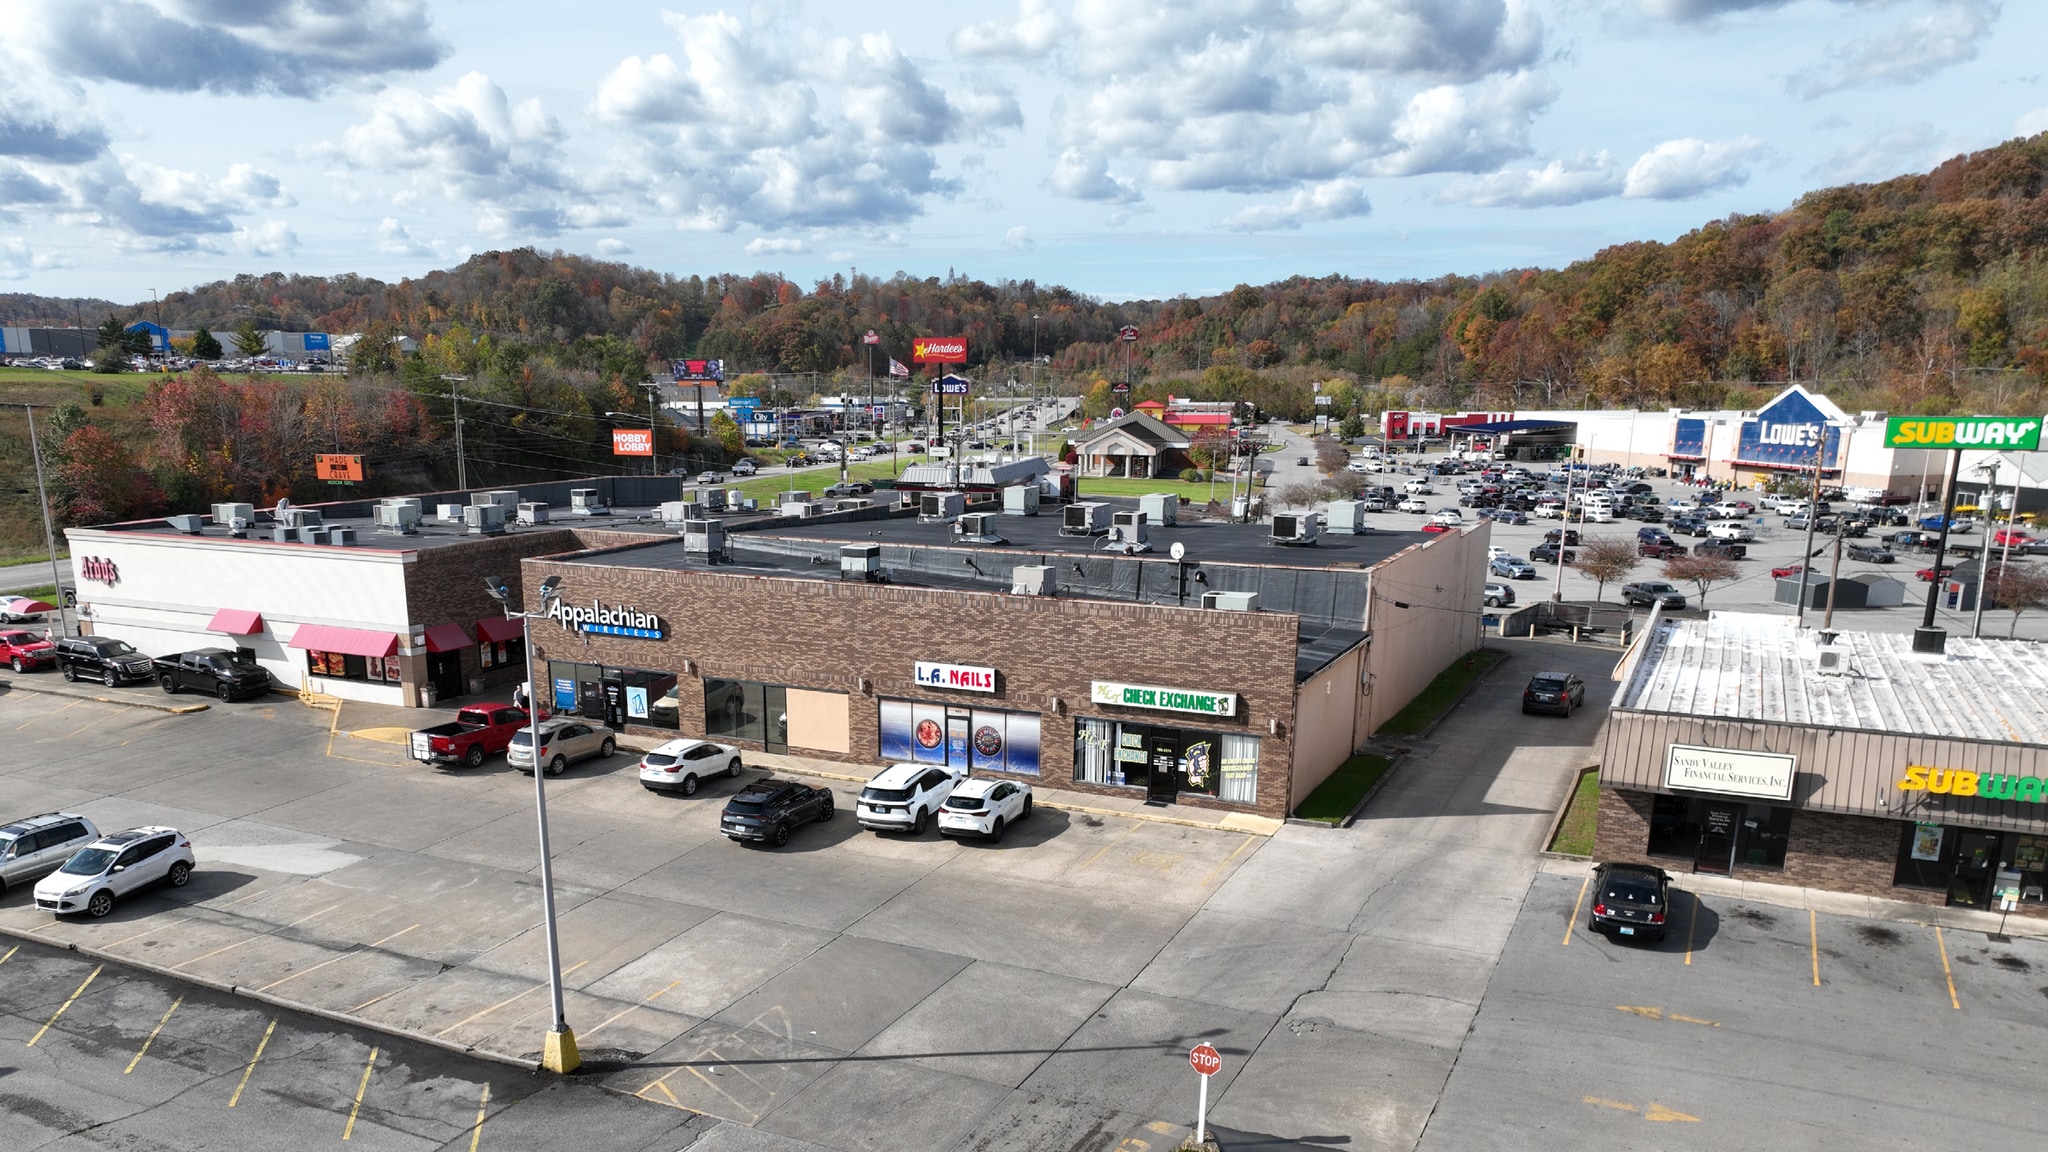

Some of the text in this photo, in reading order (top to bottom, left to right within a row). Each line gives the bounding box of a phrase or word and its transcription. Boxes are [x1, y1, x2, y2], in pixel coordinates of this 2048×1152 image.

[924, 343, 964, 354] Hardee's
[754, 412, 768, 421] City
[613, 433, 647, 443] HOBBY
[1760, 420, 1820, 448] LOWE'S
[1892, 421, 2037, 445] SUBWAY
[619, 442, 651, 452] LOBBY
[329, 456, 348, 465] MADE
[329, 470, 351, 480] CRAVE
[81, 556, 117, 585] Arby's
[547, 597, 659, 632] Appalachian
[582, 623, 661, 639] WIRELESS
[917, 666, 992, 689] L.A. NAILS
[1123, 687, 1157, 707] CHECK
[1159, 690, 1218, 713] EXCHANGE
[1121, 732, 1143, 749] CHECK
[1113, 747, 1149, 765] EXCHANGE
[1674, 755, 1735, 771] SANDY VALLEY
[1684, 767, 1726, 782] FINANCIAL
[1769, 775, 1787, 788] INC.
[1896, 765, 2048, 803] SUBWA
[1192, 1052, 1220, 1068] STOP
